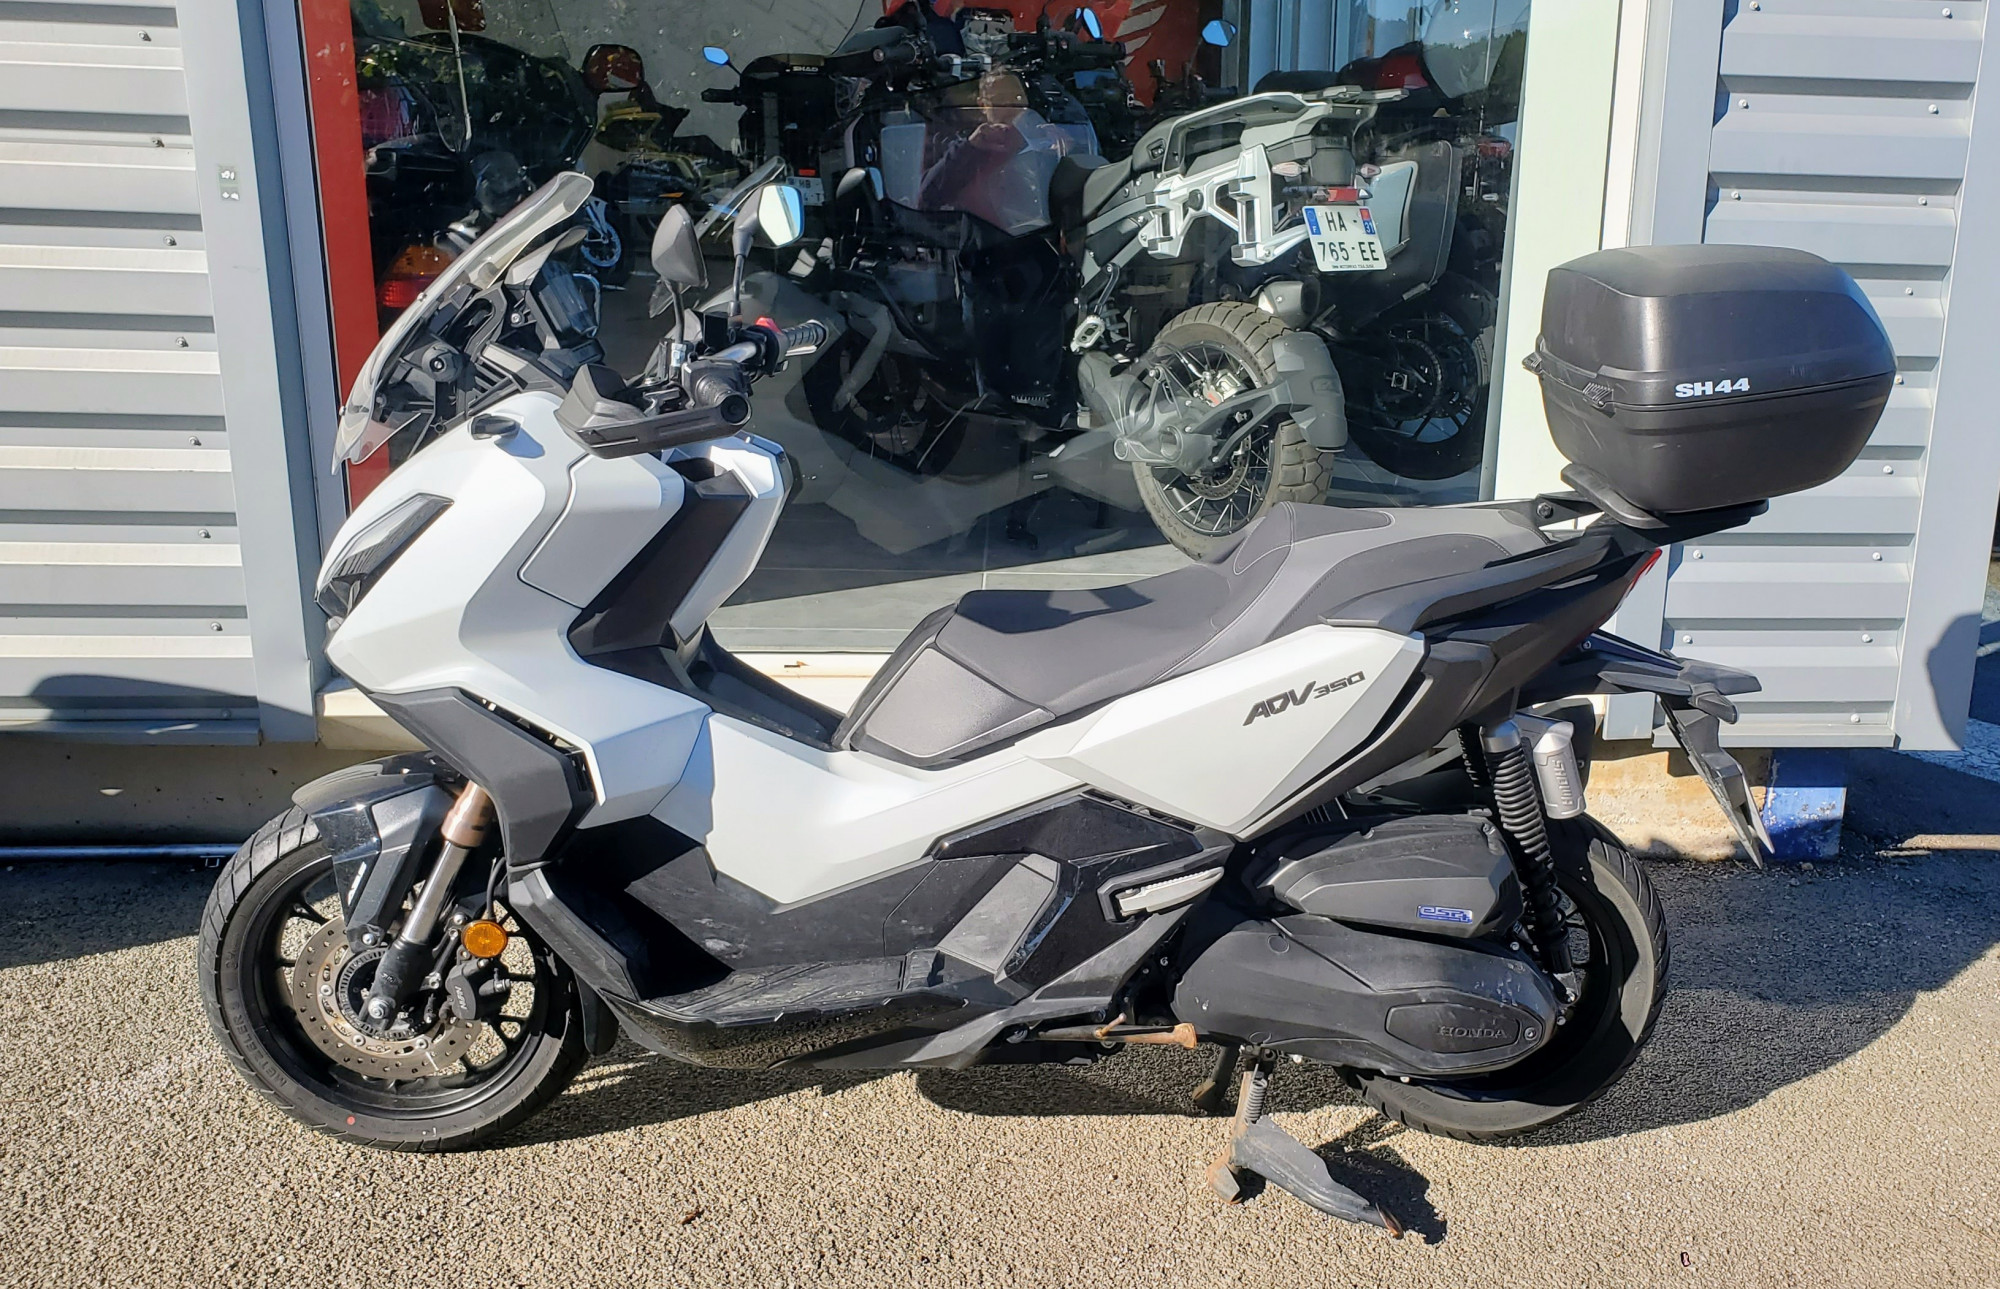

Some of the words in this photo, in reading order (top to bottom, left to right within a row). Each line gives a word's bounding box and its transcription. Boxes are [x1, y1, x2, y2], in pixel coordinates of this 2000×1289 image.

[1364, 221, 1376, 234] 31
[1317, 241, 1380, 262] 765-EE
[1437, 1025, 1509, 1039] HONDA
